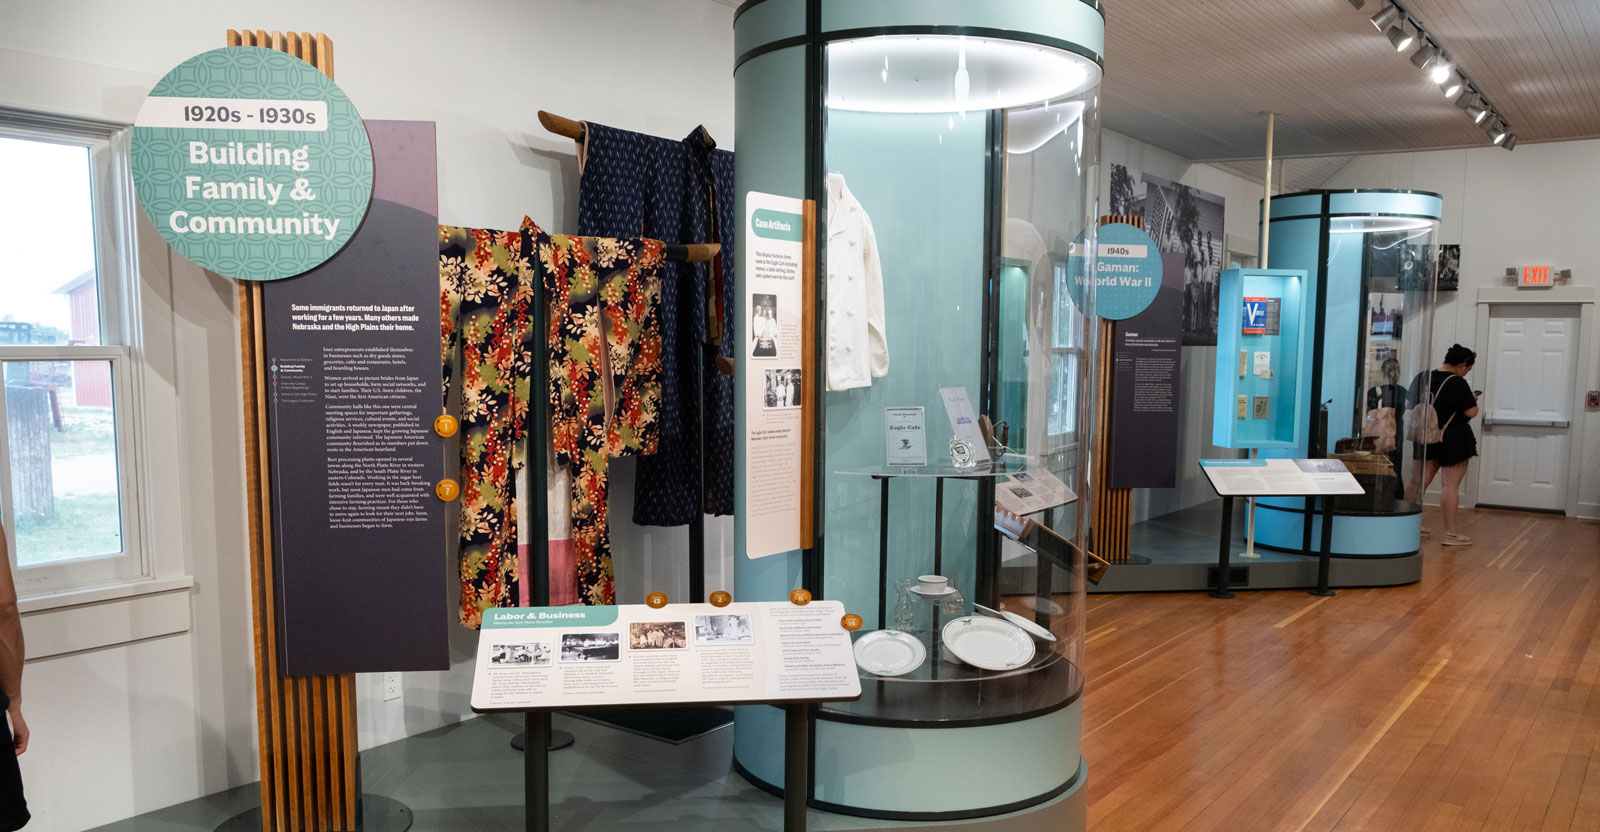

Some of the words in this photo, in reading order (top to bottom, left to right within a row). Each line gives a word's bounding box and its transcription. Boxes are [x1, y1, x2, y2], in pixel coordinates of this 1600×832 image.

[184, 105, 241, 123] 1920s
[259, 107, 316, 125] 1930s
[189, 141, 309, 171] Building
[185, 176, 283, 206] Family
[290, 178, 316, 201] &
[169, 210, 340, 240] Community
[756, 218, 768, 228] Case
[769, 220, 792, 232] Artifacts
[1097, 262, 1140, 272] Gaman:
[1524, 266, 1550, 284] EXIT
[1120, 277, 1142, 287] War
[1145, 277, 1152, 287] II
